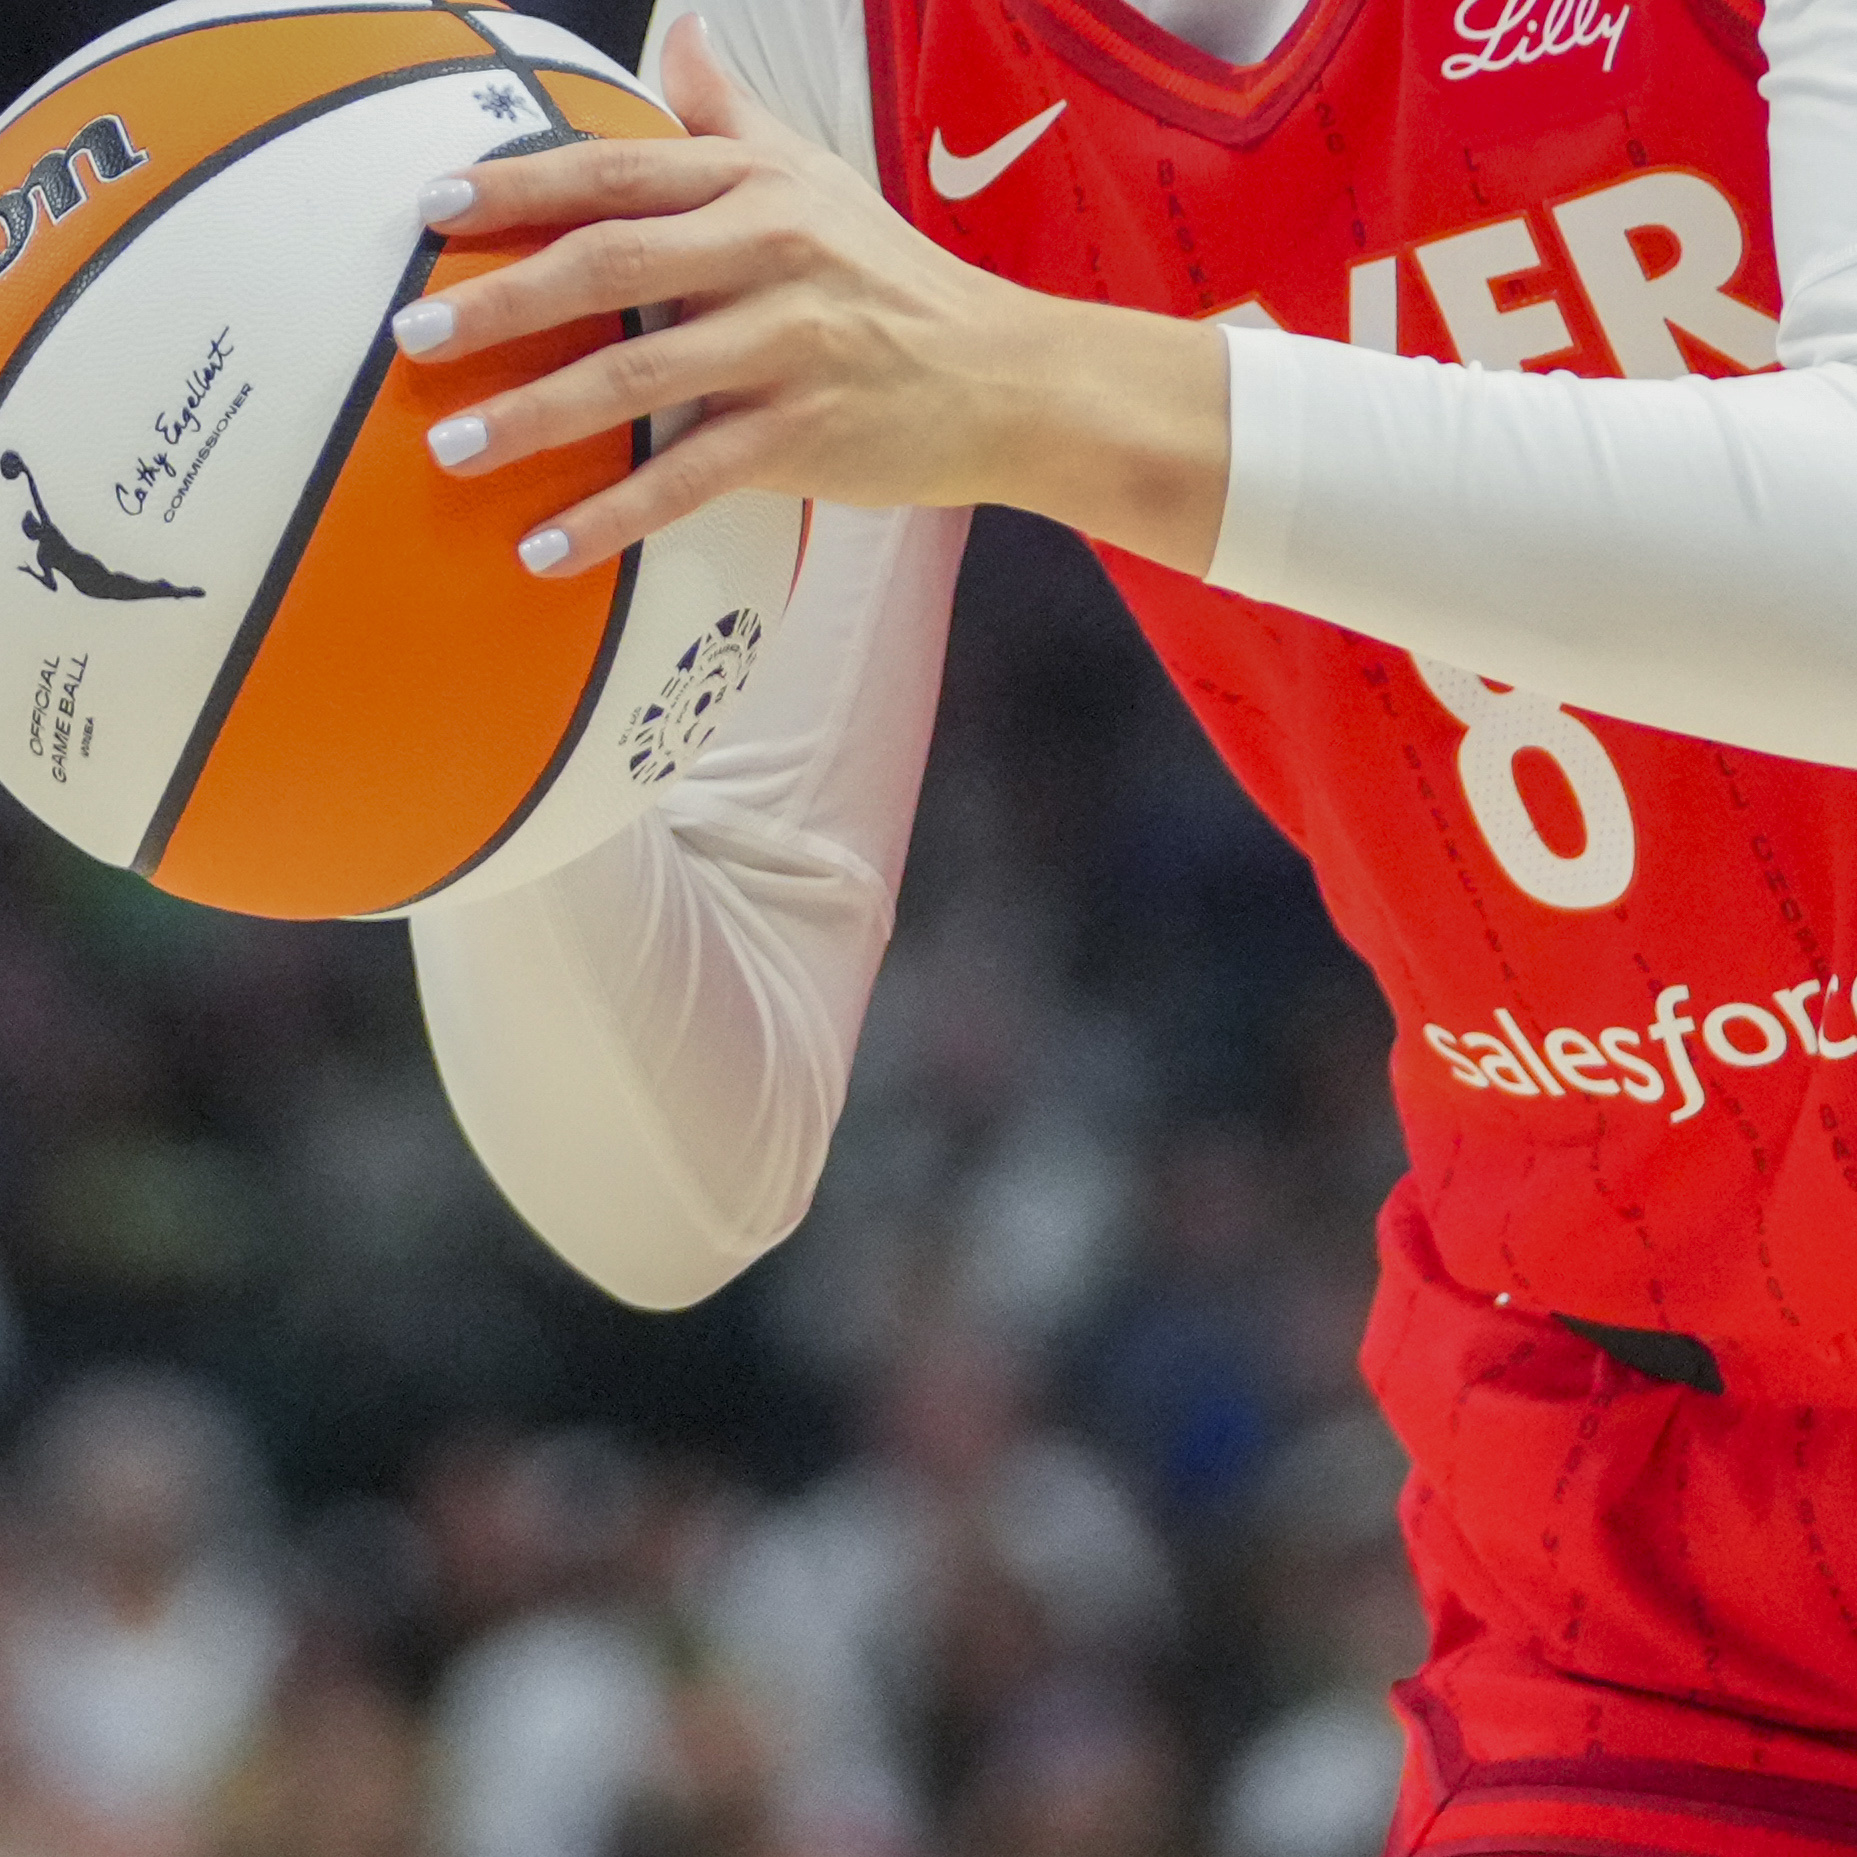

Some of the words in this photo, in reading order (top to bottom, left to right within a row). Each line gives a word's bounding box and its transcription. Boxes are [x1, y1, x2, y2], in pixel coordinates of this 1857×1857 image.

[162, 381, 255, 524] COMMISSIONER
[28, 654, 61, 757] OFFICIAL
[58, 651, 90, 719] BALL
[51, 716, 72, 785] GAME
